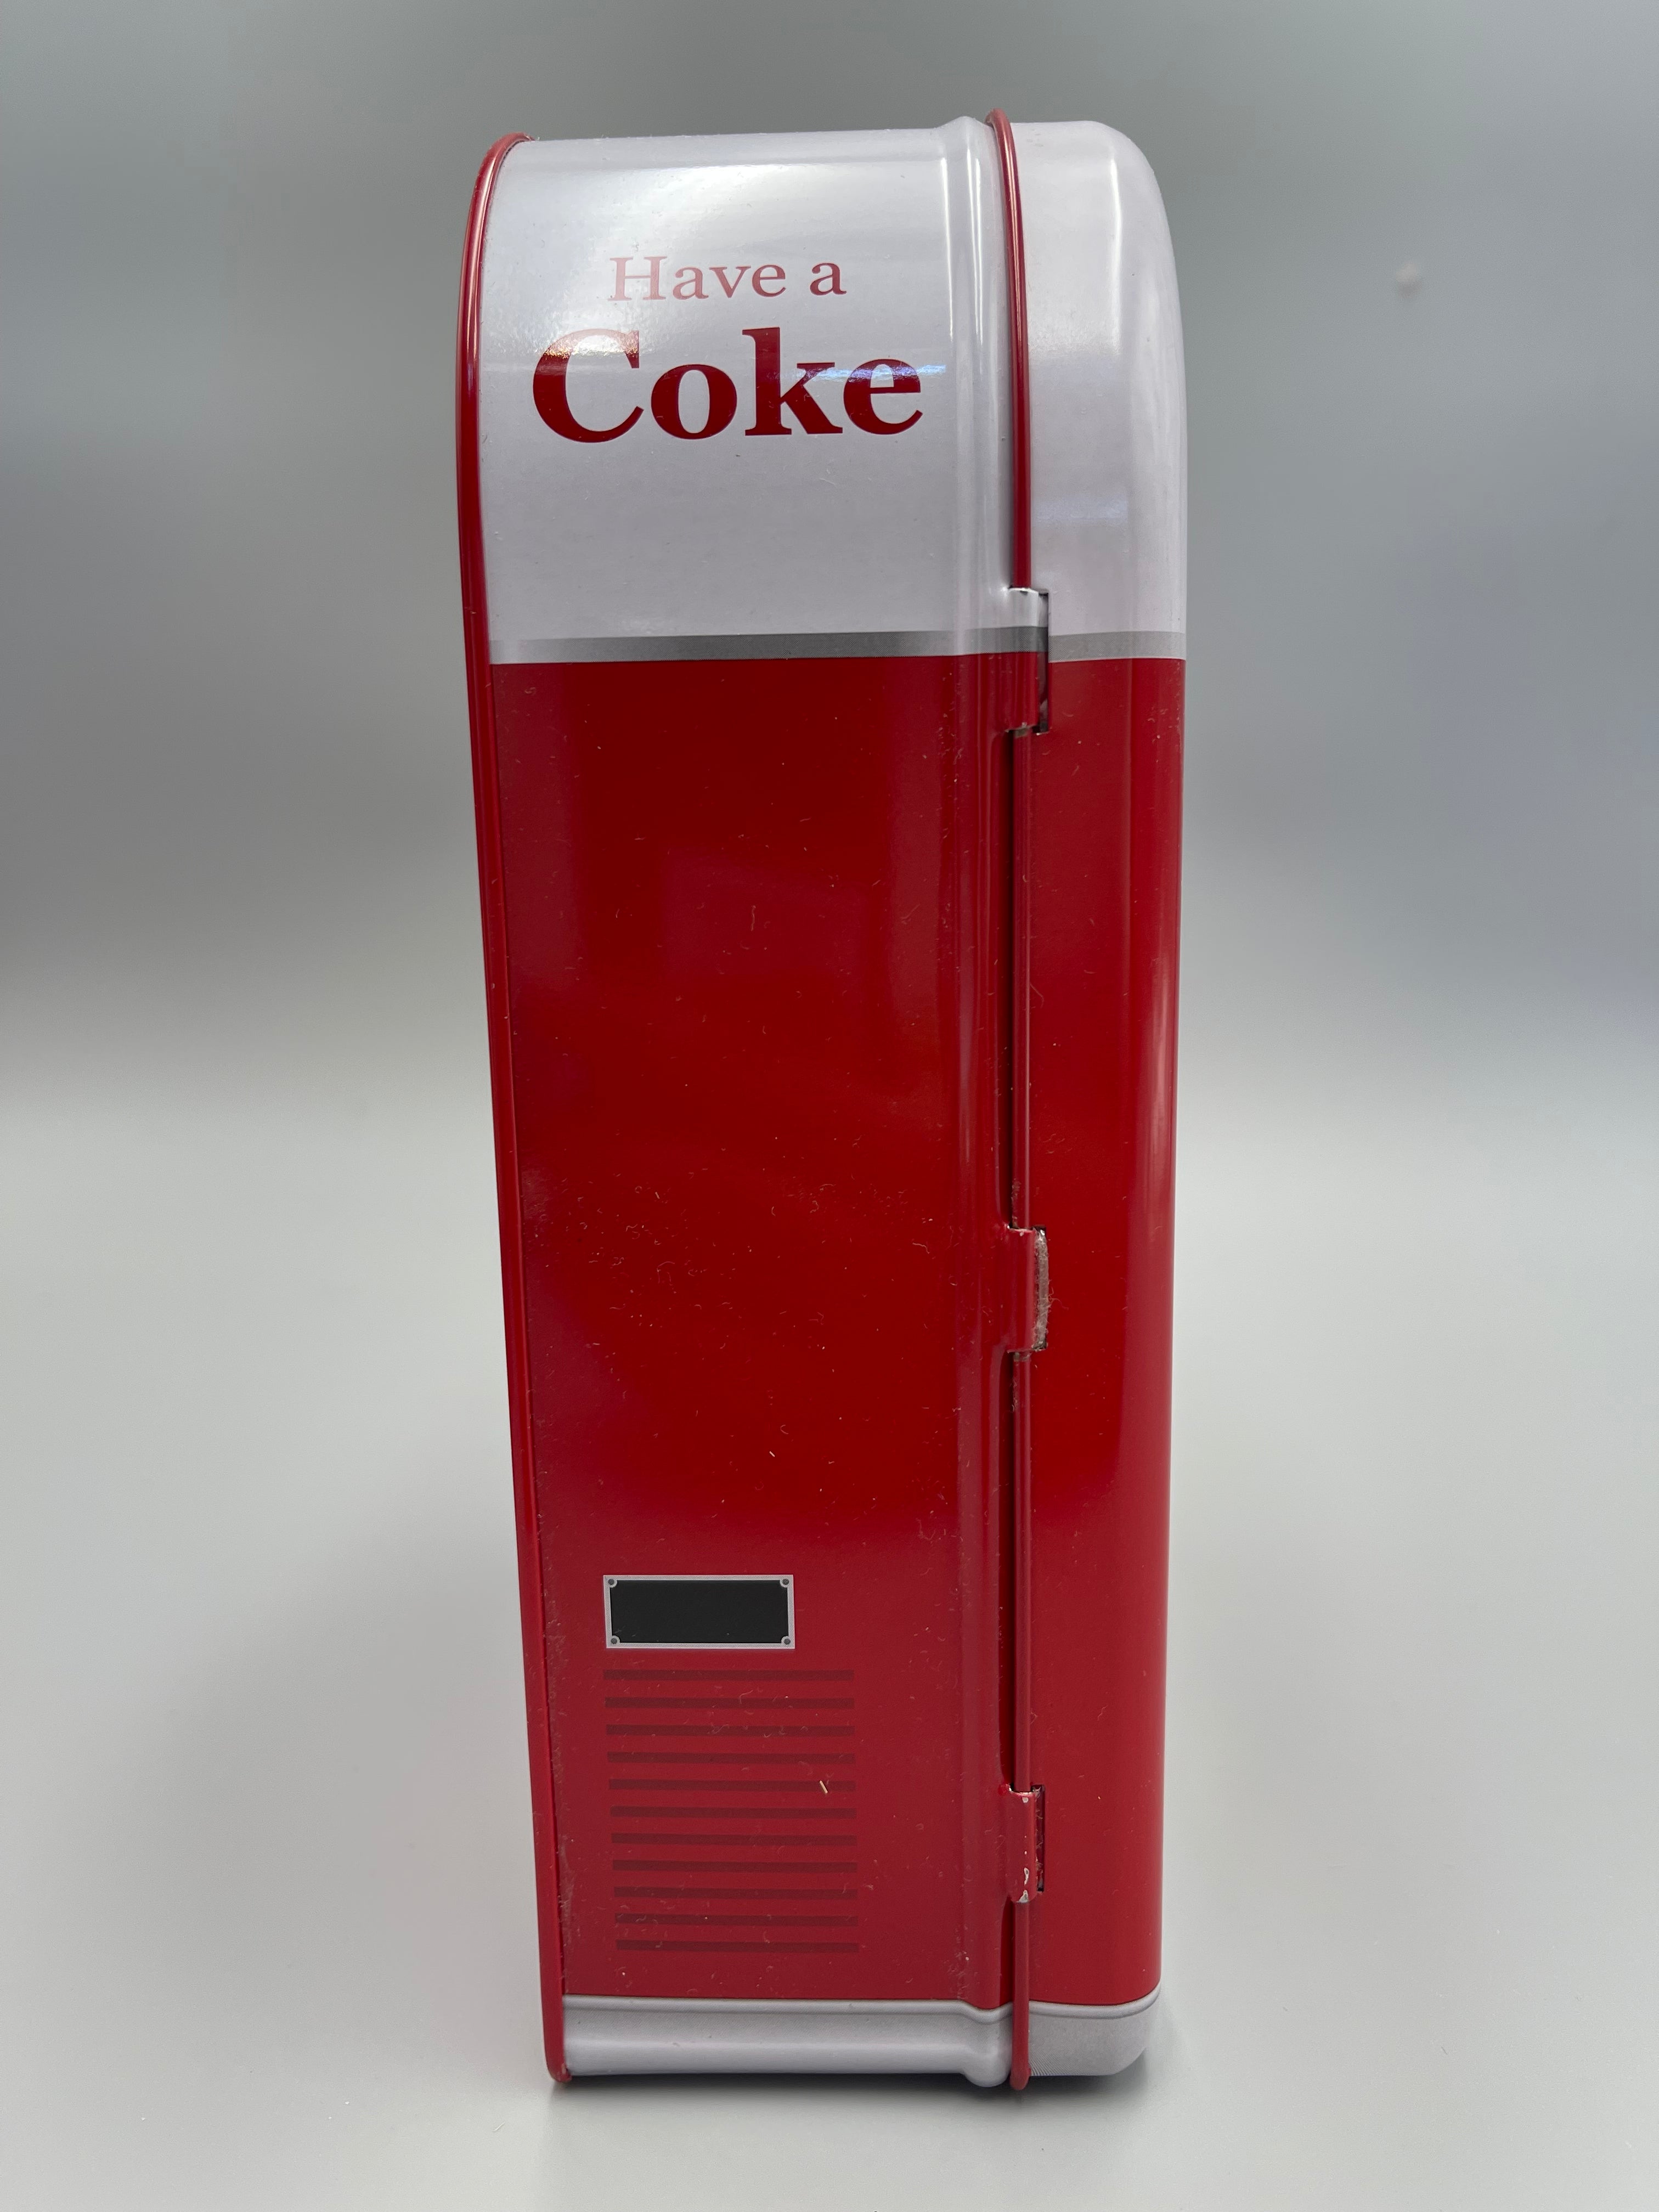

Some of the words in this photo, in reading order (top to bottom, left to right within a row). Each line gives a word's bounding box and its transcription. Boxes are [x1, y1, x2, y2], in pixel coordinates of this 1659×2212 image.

[608, 256, 786, 301] Have
[810, 262, 847, 296] a
[532, 326, 923, 443] Coke
